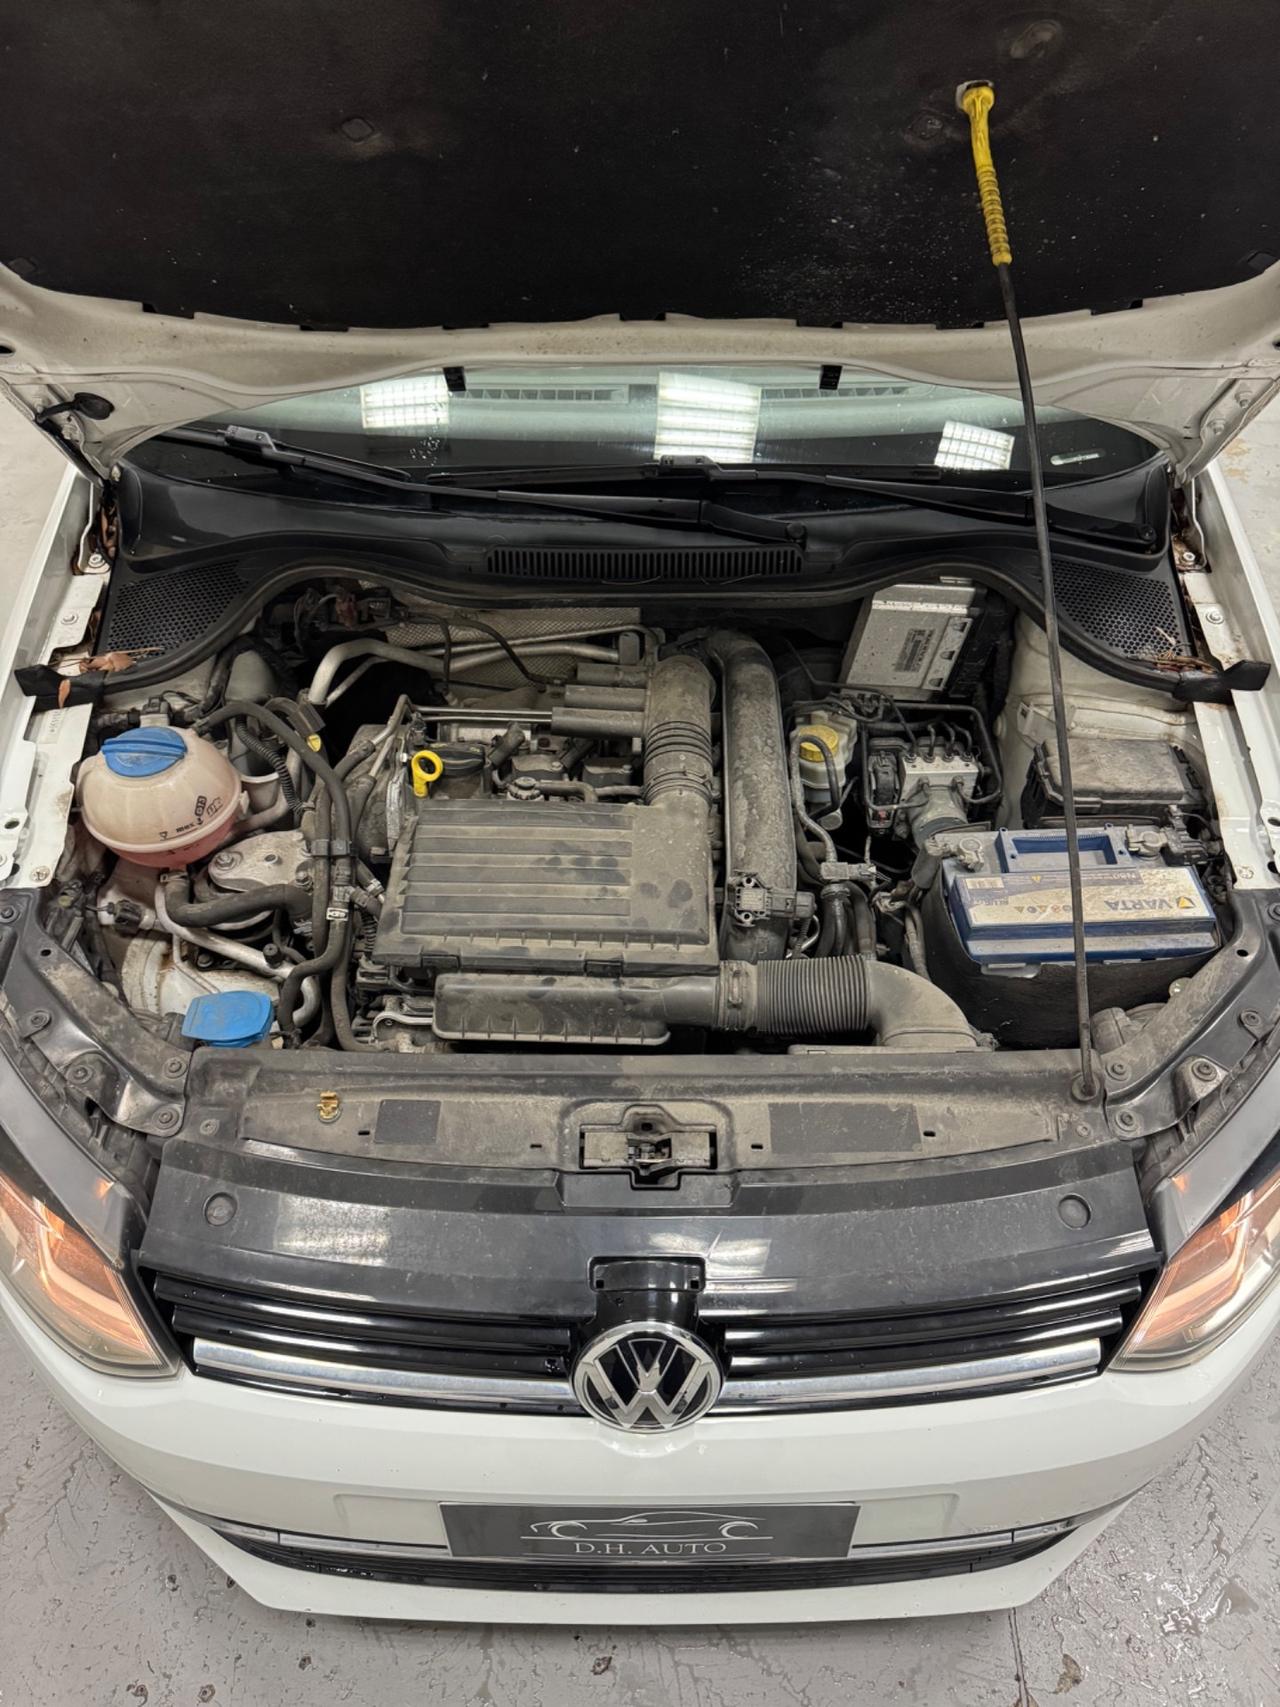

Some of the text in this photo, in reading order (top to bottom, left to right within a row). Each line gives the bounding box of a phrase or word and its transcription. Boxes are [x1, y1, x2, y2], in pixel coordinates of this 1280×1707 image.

[1105, 897, 1172, 911] VARTA
[575, 1542, 727, 1555] D.H. AUTO
